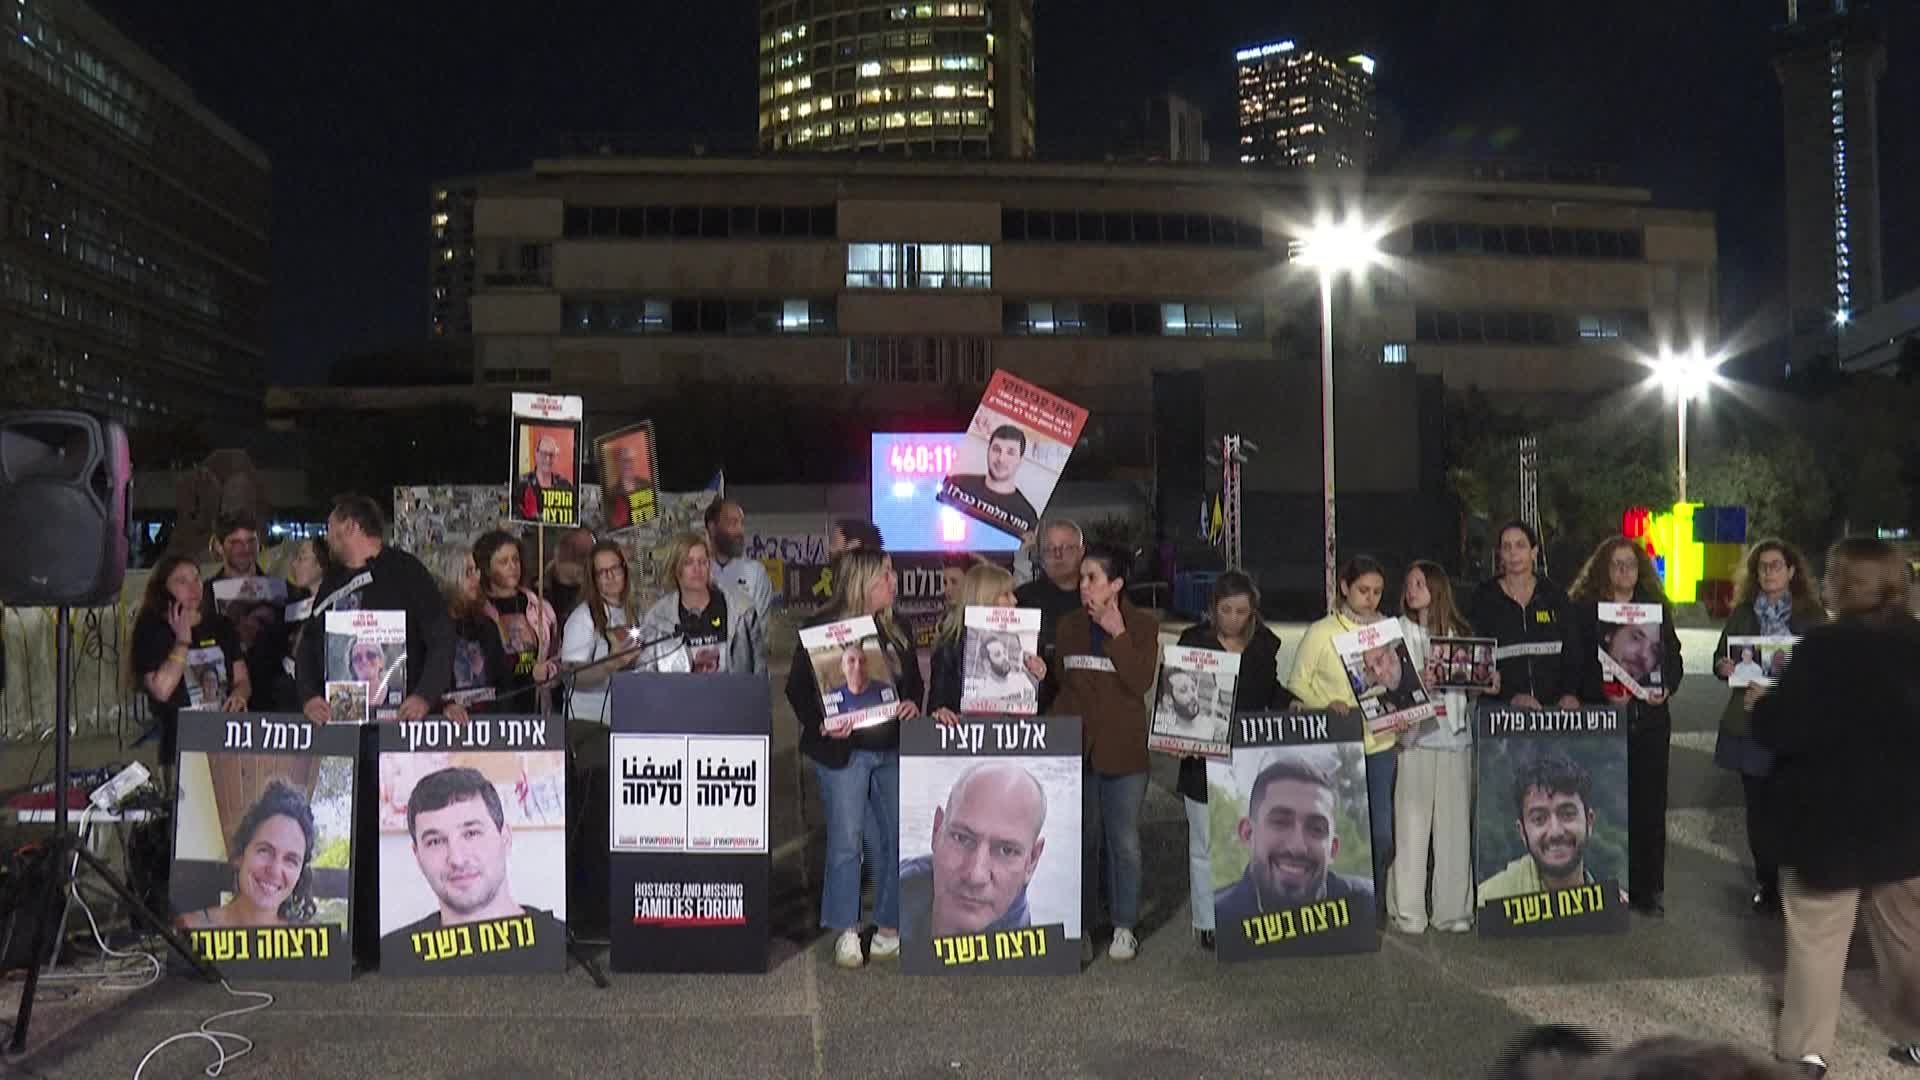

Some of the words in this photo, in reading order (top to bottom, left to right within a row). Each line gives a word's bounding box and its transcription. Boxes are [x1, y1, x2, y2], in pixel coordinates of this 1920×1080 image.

[543, 490, 572, 506] הופקר
[977, 500, 1008, 520] תלמדו
[543, 507, 572, 524] ונרצח
[1010, 515, 1029, 531] מתי
[262, 718, 313, 750] כרמל
[499, 719, 546, 747] איתי
[992, 719, 1047, 750] אלעד
[1240, 716, 1285, 743] דנינו
[1290, 713, 1329, 740] אורי
[1488, 710, 1525, 735] פולין
[1529, 709, 1583, 732] גולדברג
[1588, 710, 1617, 730] הרש
[224, 721, 257, 750] גת
[400, 719, 491, 752] סבירסקי
[935, 723, 985, 754] קציר
[622, 781, 682, 805] סליחה
[696, 781, 757, 807] סליחה
[634, 882, 681, 897] HOSTAGES
[682, 883, 701, 897] AND
[702, 882, 743, 898] MISSING
[1557, 884, 1604, 918] נרצח
[634, 898, 693, 920] FAMILIES
[696, 899, 744, 920] FORUM
[1300, 898, 1352, 936] נרצח
[1503, 894, 1554, 925] בשבי
[257, 927, 329, 958] נרצחה
[411, 926, 470, 961] בשבי
[479, 916, 535, 951] נרצח
[1242, 913, 1298, 945] בשבי
[190, 930, 250, 961] בשבי
[933, 934, 989, 966] בשבי
[995, 928, 1047, 960] נרצח
